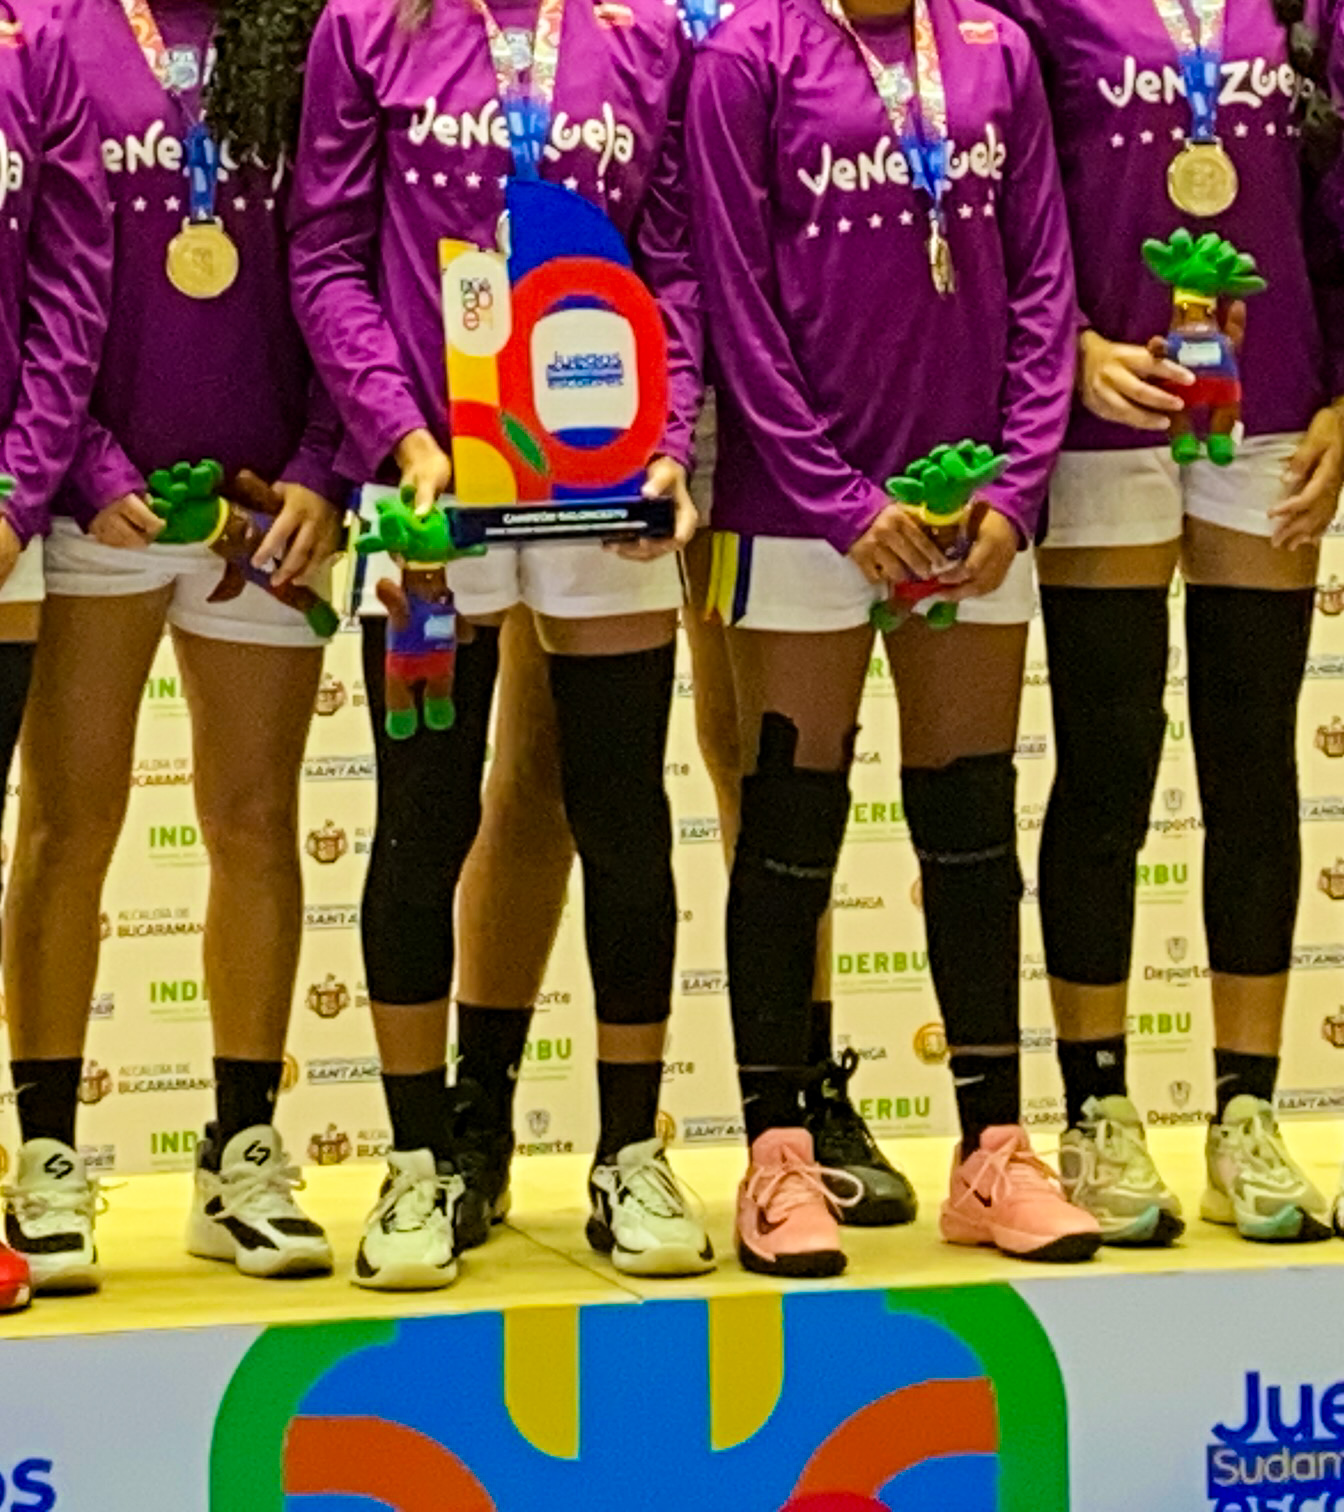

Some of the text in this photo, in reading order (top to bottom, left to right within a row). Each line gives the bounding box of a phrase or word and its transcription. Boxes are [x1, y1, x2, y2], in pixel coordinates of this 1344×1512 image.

[306, 912, 358, 925] SANTA
[118, 922, 205, 939] BUCARAMAN
[837, 951, 927, 975] DERBU
[118, 1076, 210, 1094] BUCARAMAN
[860, 1096, 931, 1121] ERBU
[519, 1140, 573, 1156] eporte
